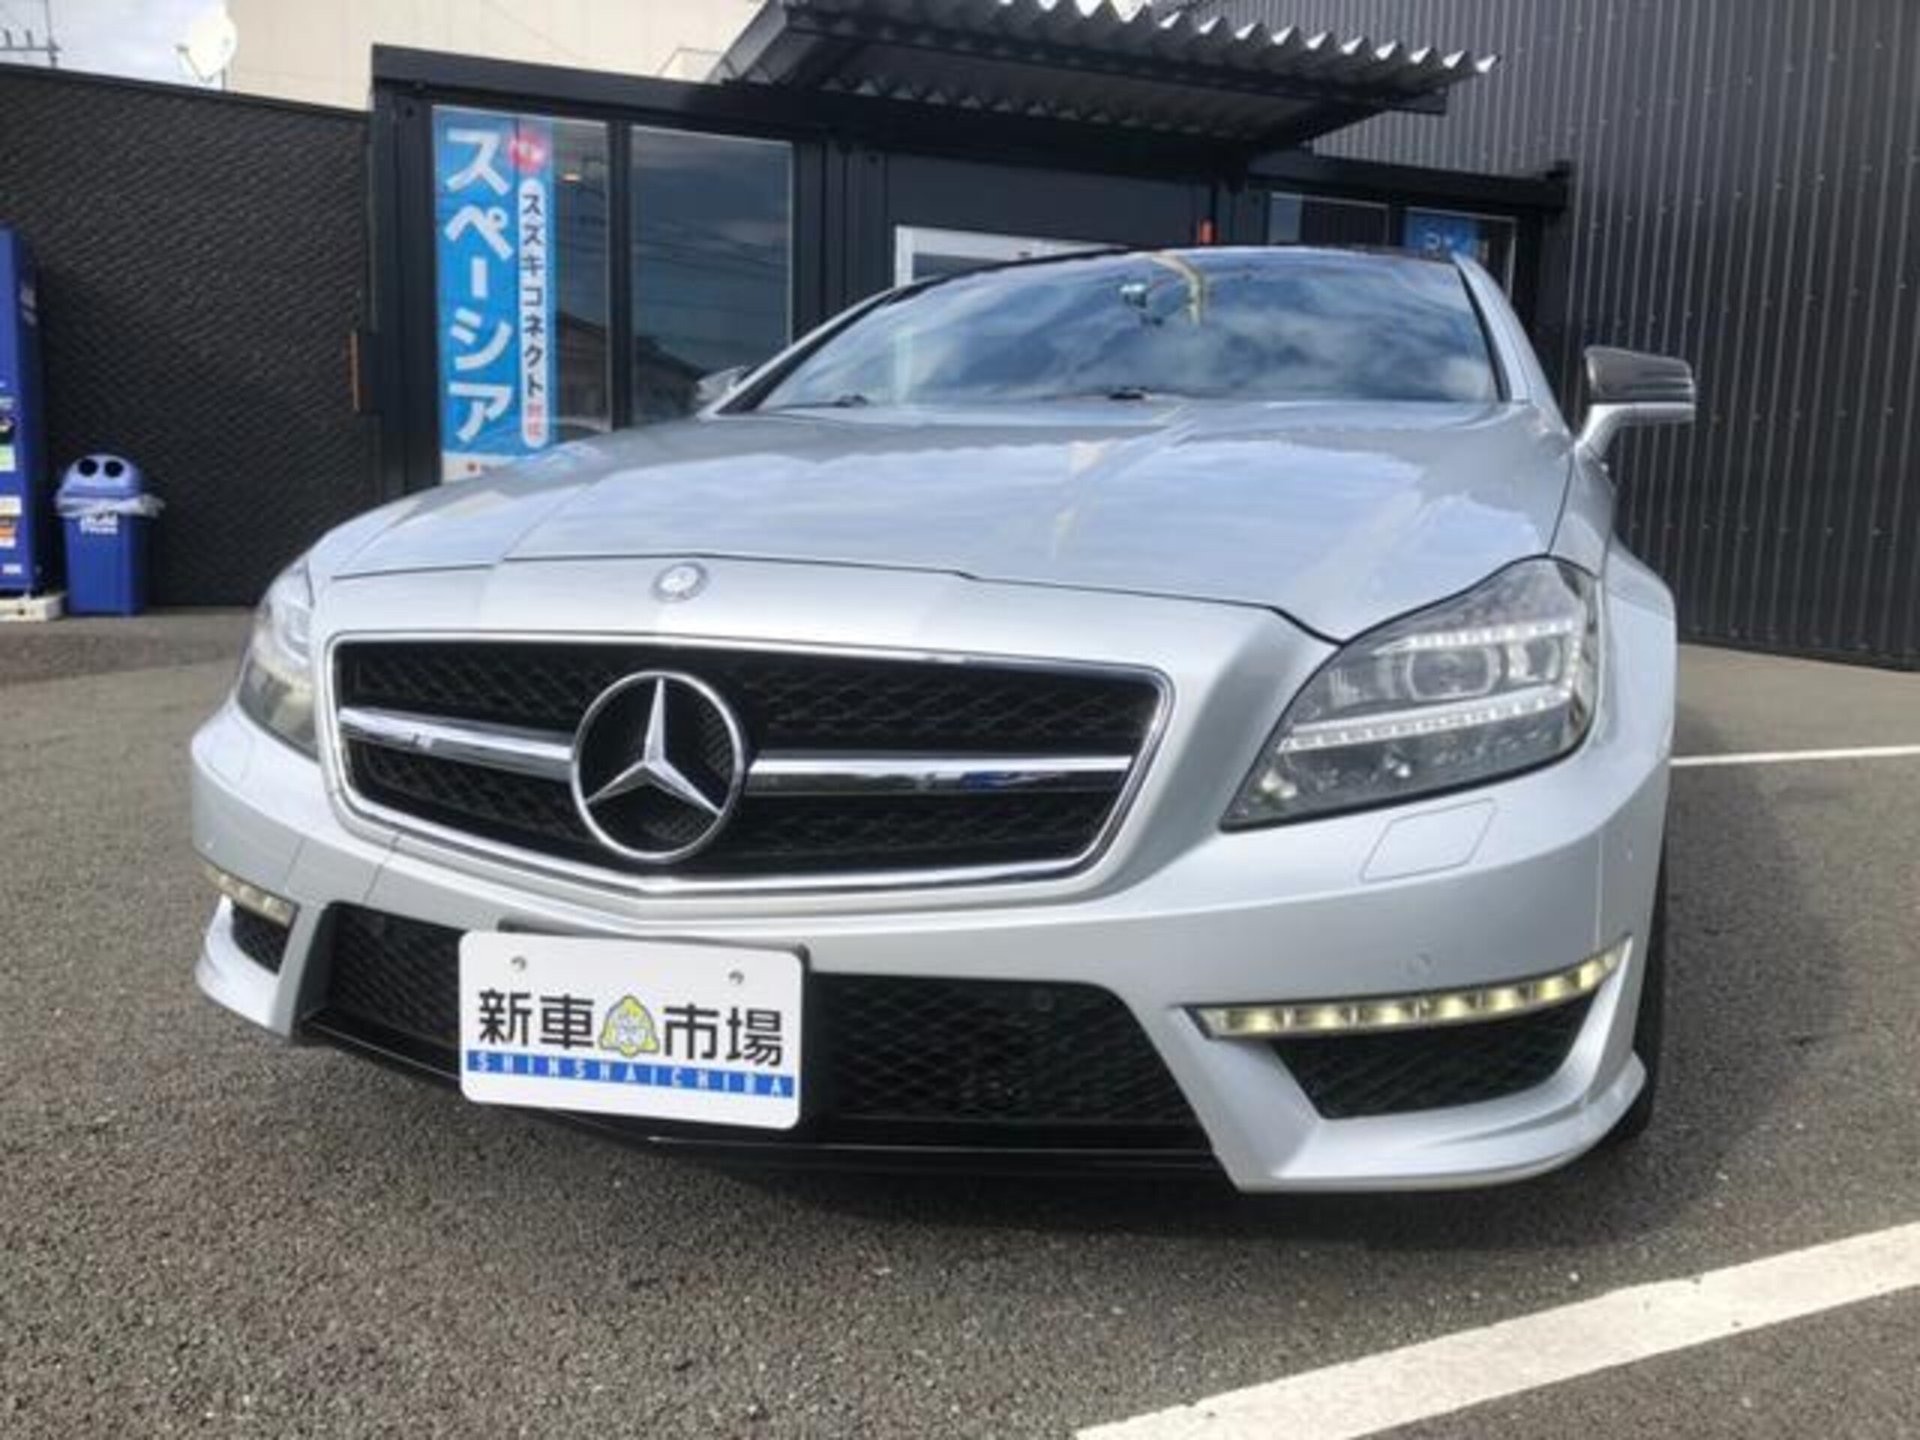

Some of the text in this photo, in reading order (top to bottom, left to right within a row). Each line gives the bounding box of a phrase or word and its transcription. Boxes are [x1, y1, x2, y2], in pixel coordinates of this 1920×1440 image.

[444, 127, 514, 443] スペーシア
